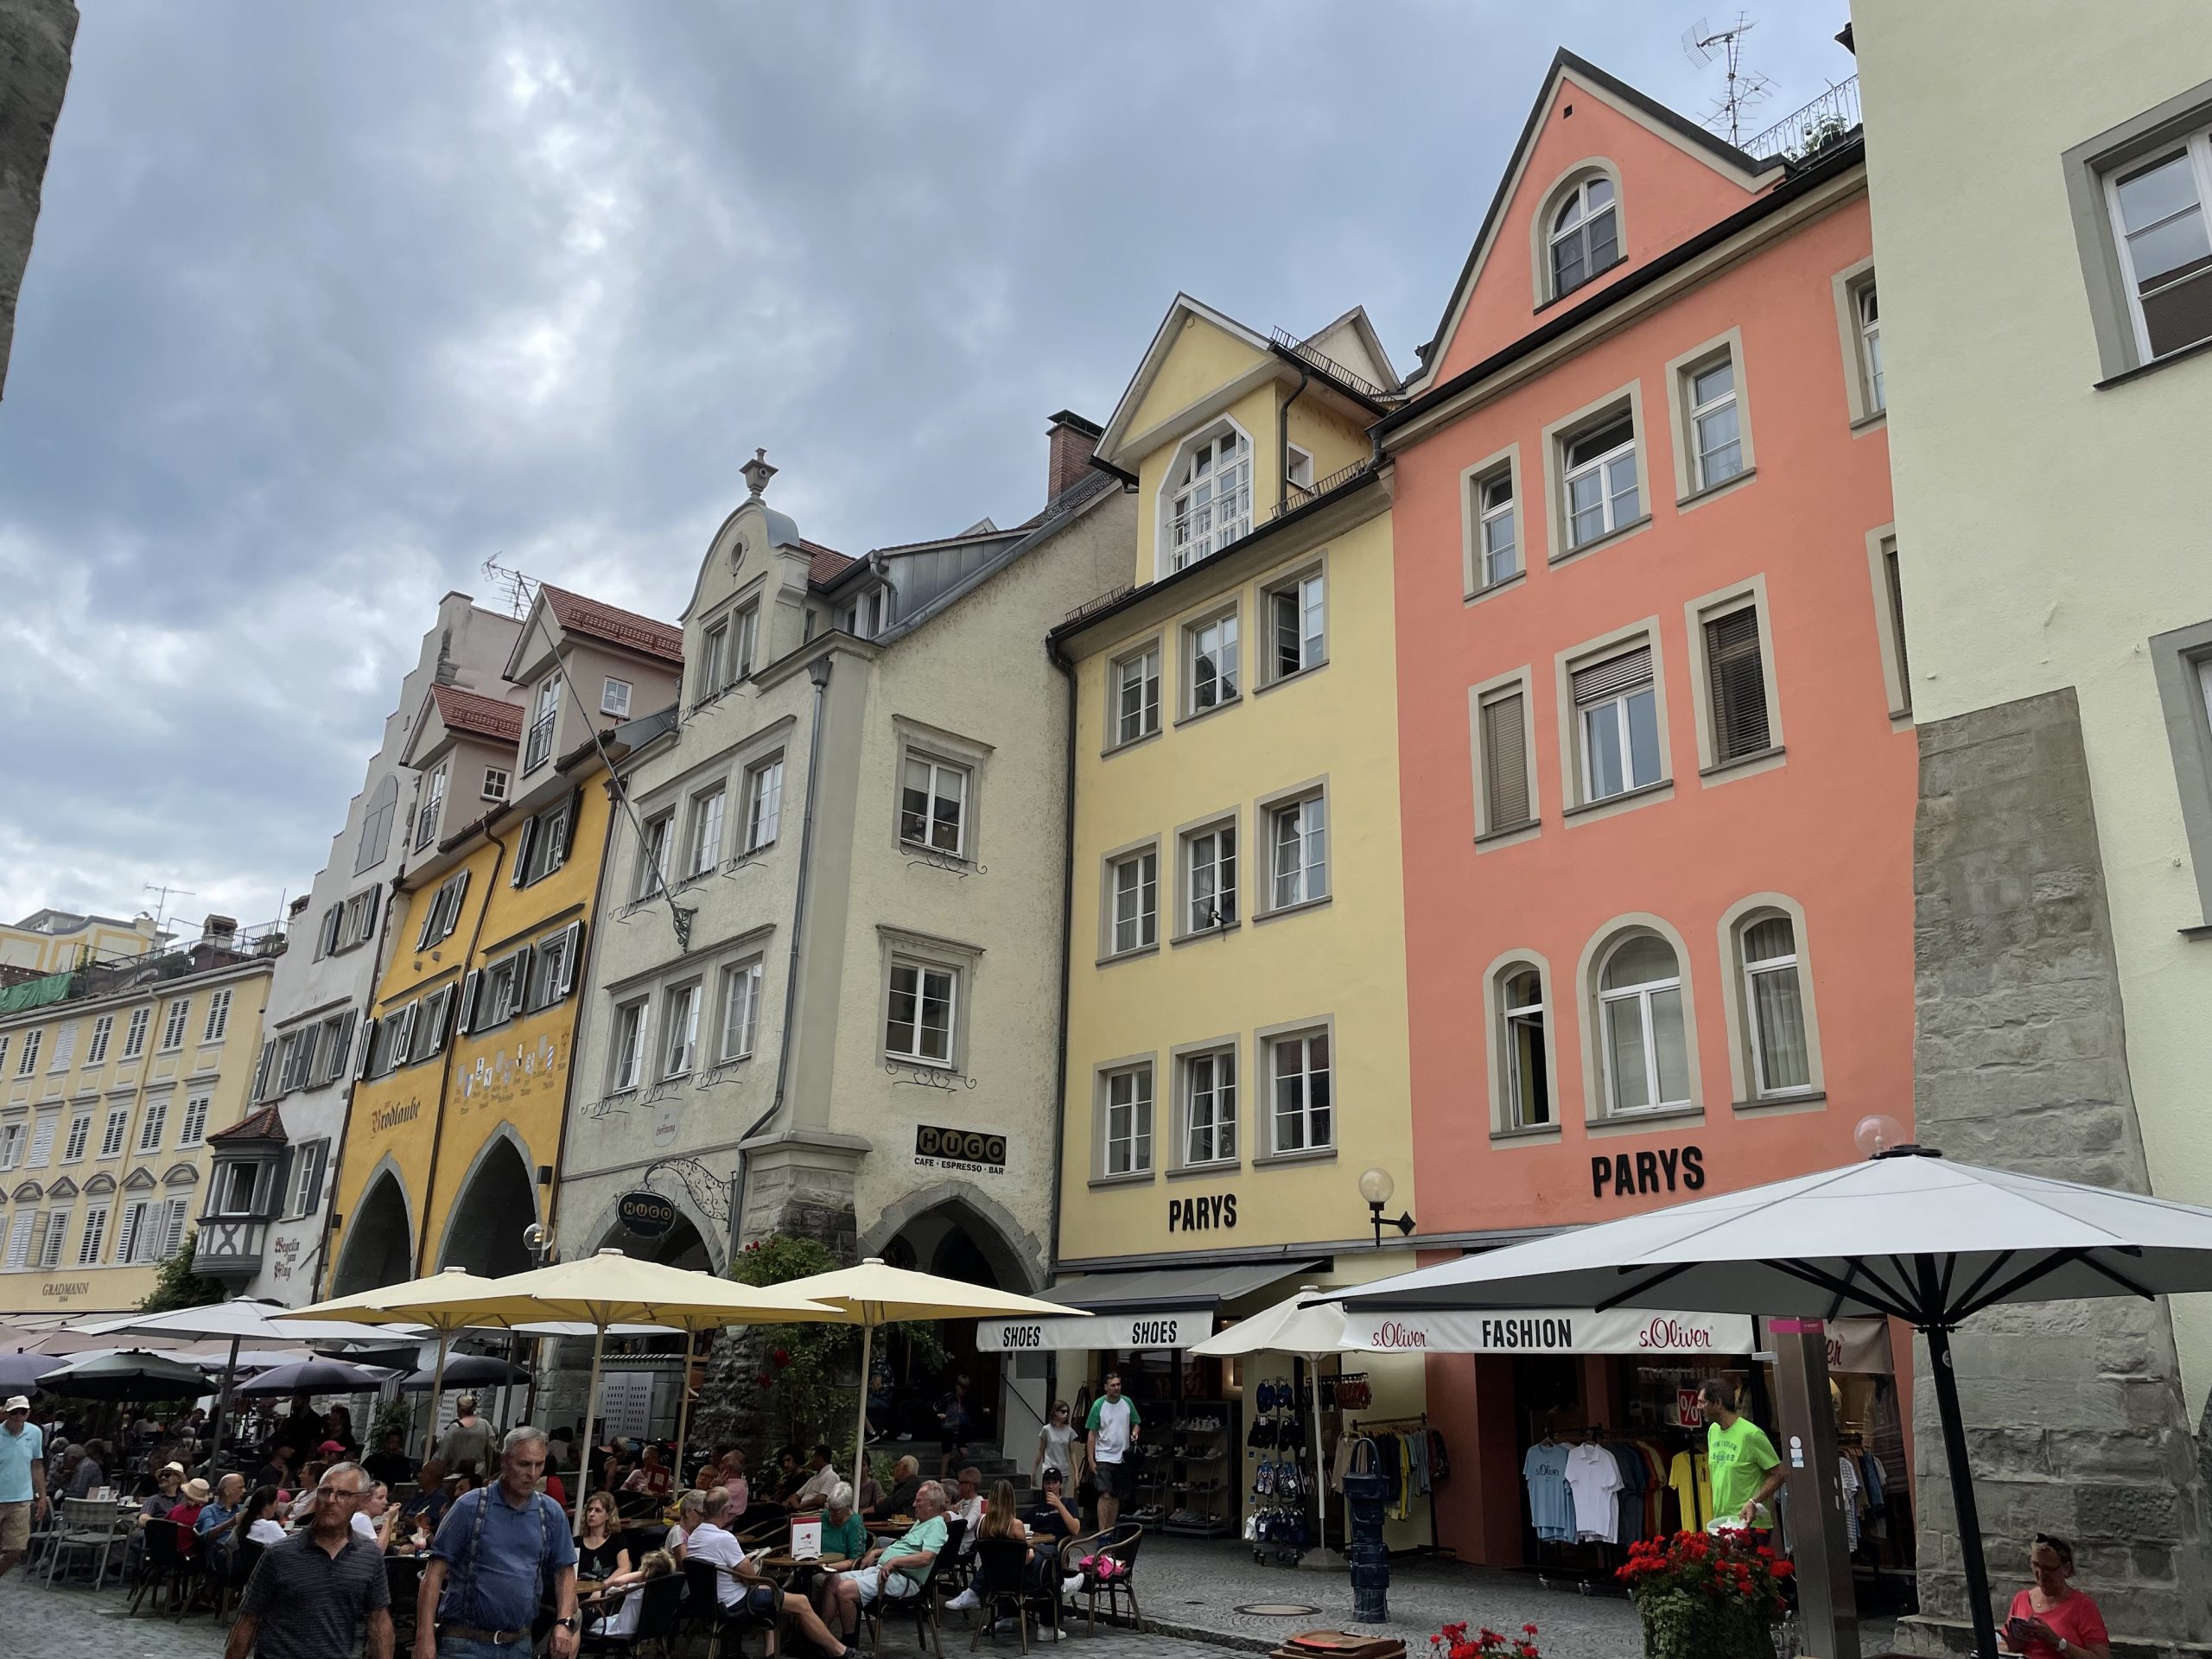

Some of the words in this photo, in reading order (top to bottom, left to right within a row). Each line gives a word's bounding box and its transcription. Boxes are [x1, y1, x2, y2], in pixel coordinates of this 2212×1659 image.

[920, 1129, 1004, 1160] HUGO
[914, 1157, 934, 1166] CAFE
[941, 1160, 982, 1173] ESPRESSO
[988, 1166, 1003, 1175] BAR
[1591, 1146, 1705, 1198] PARYS
[624, 1202, 671, 1218] HUGO
[1169, 1193, 1236, 1232] PARYS
[42, 1282, 89, 1296] GRADMANN
[1003, 1326, 1041, 1347] SHOES
[1132, 1320, 1178, 1344] SHOES
[1482, 1319, 1573, 1348] FASHION
